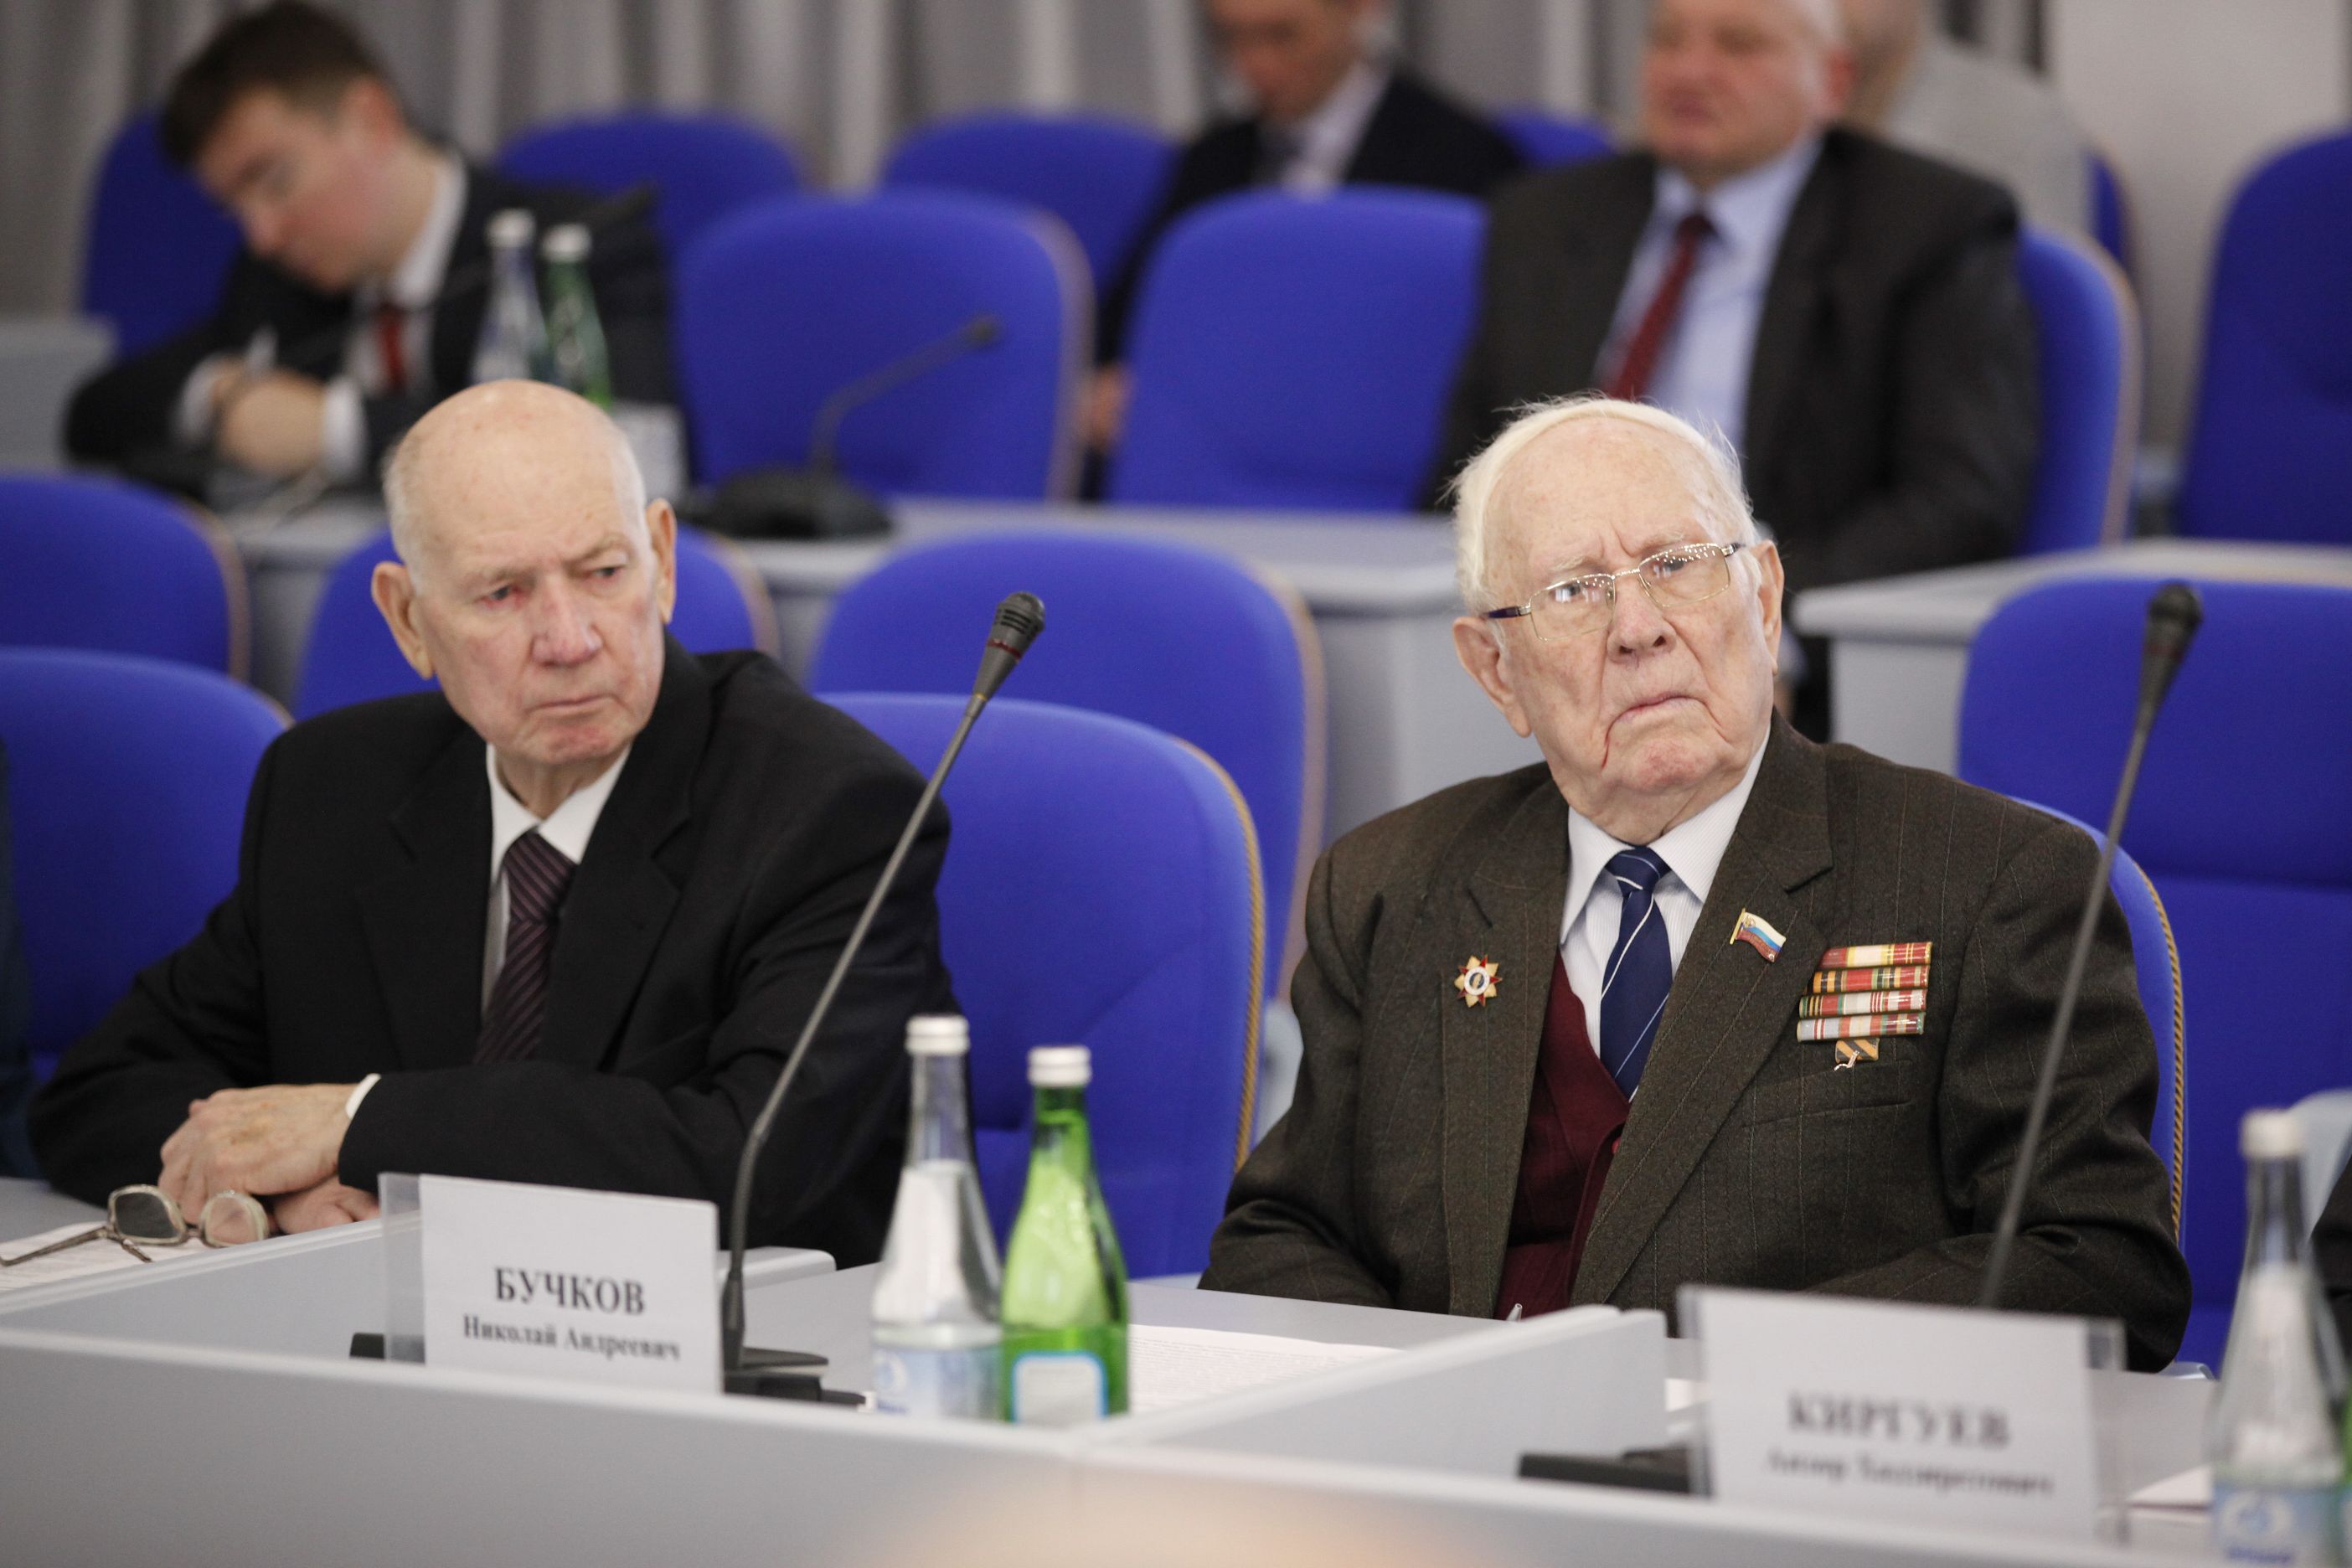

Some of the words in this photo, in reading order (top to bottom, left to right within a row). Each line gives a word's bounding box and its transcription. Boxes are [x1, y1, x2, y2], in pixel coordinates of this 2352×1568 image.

[495, 1266, 645, 1315] БУЧКОВ
[462, 1314, 557, 1346] Николай
[565, 1328, 680, 1361] Андреевич
